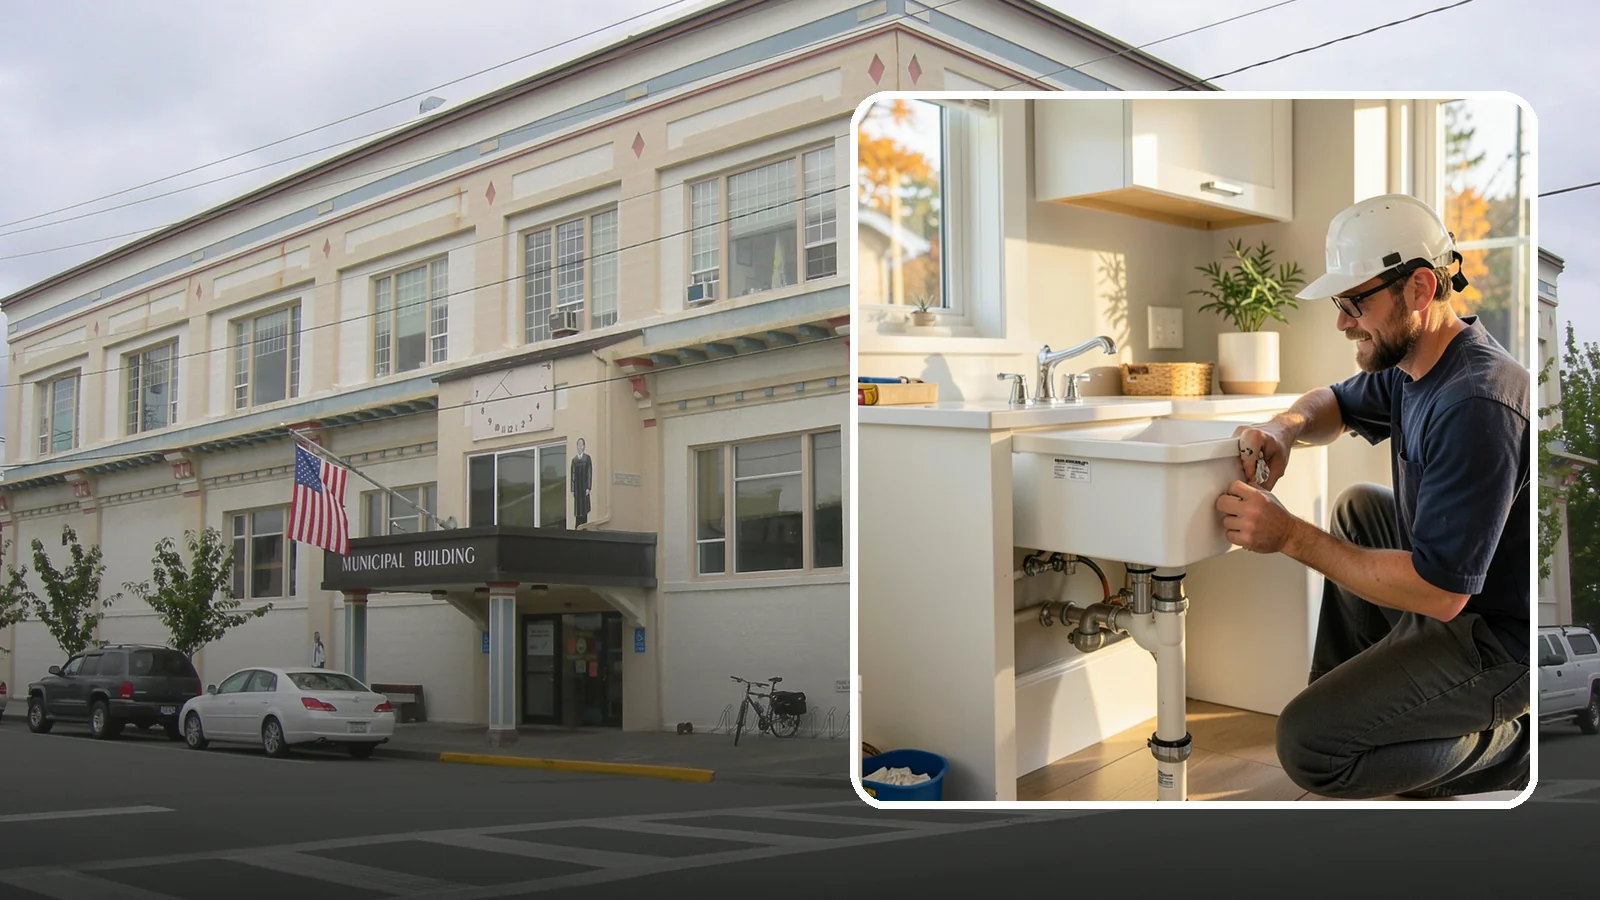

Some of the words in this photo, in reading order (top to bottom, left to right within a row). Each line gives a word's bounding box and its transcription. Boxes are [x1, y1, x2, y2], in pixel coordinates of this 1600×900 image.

[488, 418, 492, 426] 9
[494, 424, 500, 432] 10
[529, 414, 533, 422] 3
[342, 552, 405, 572] MUNICIPAL
[414, 547, 475, 567] BUILDING
